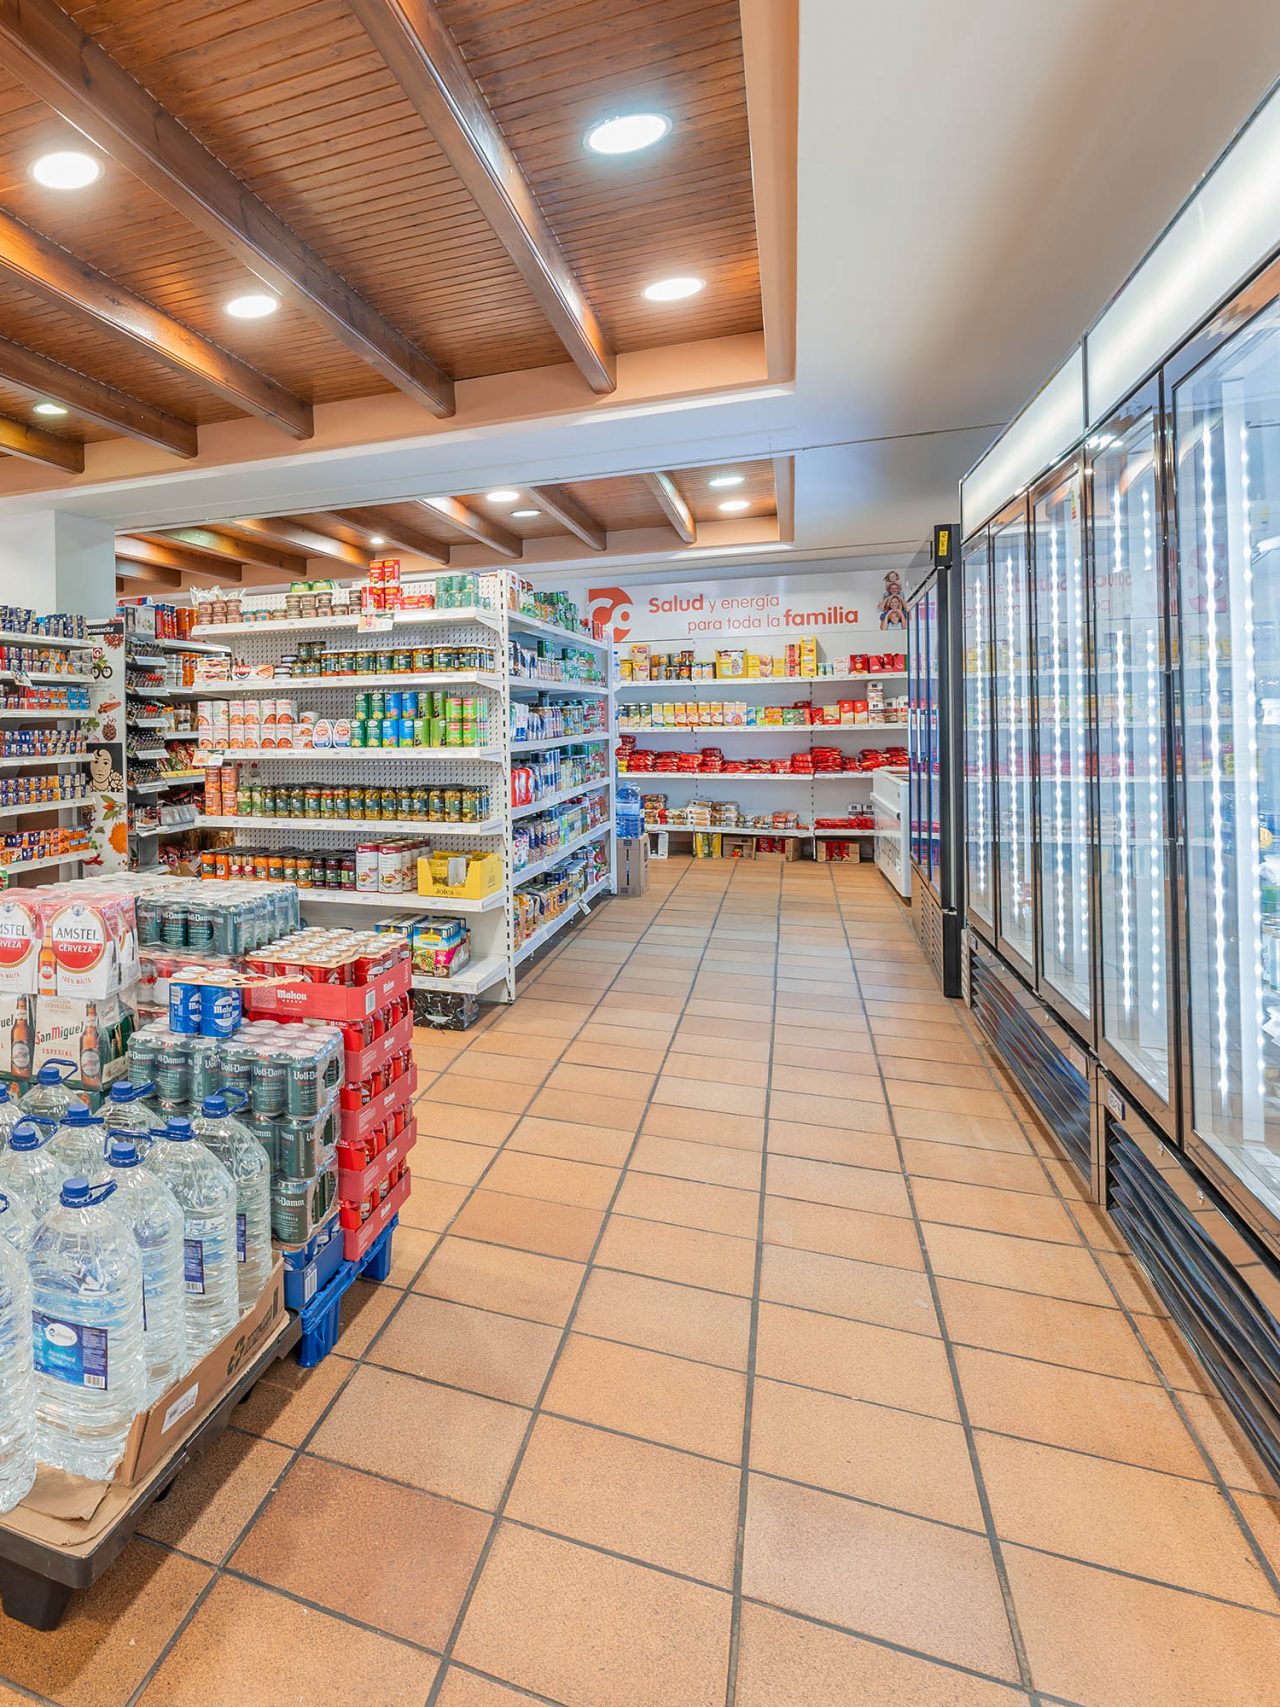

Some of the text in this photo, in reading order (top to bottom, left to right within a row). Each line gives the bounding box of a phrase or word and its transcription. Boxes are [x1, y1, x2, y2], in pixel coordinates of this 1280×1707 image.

[648, 593, 780, 614] Salud y energía
[687, 606, 859, 634] para toda la familia
[55, 927, 99, 941] AMSTEL
[58, 943, 93, 954] CERVEZA
[277, 989, 307, 1000] Mahou
[42, 1048, 73, 1057] ESPECIAL
